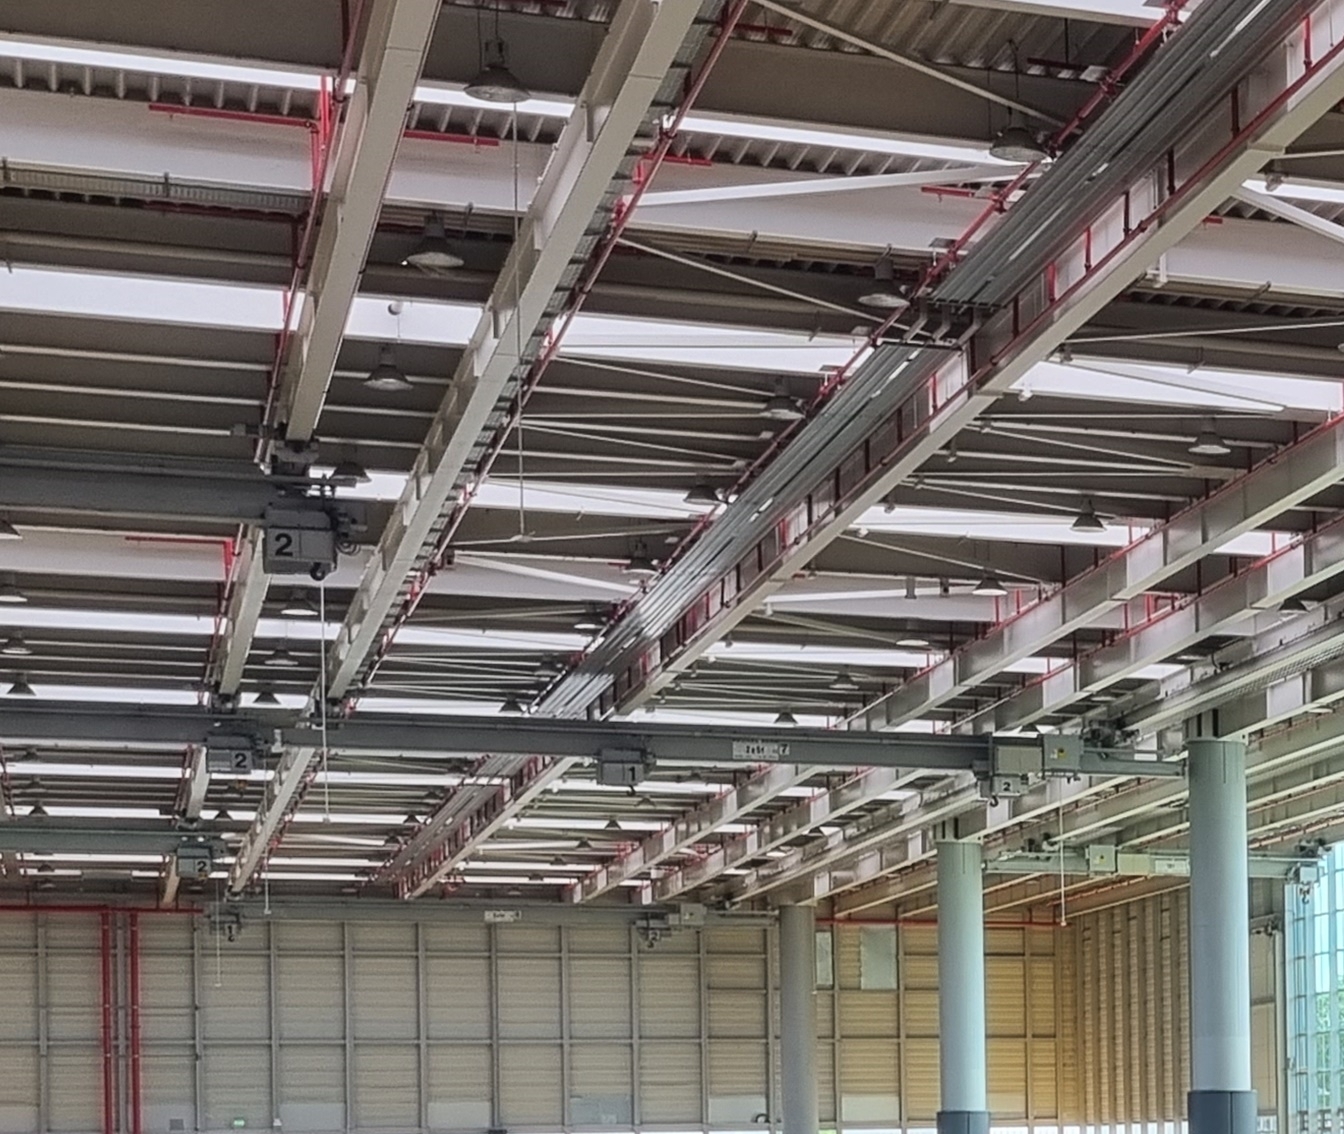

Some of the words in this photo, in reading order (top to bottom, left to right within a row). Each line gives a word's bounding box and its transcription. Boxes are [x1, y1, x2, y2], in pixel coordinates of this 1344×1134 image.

[275, 533, 293, 556] 2
[780, 743, 788, 754] 7
[234, 753, 247, 768] 2
[628, 766, 635, 781] 1
[1003, 782, 1010, 791] 2
[197, 861, 206, 873] 2
